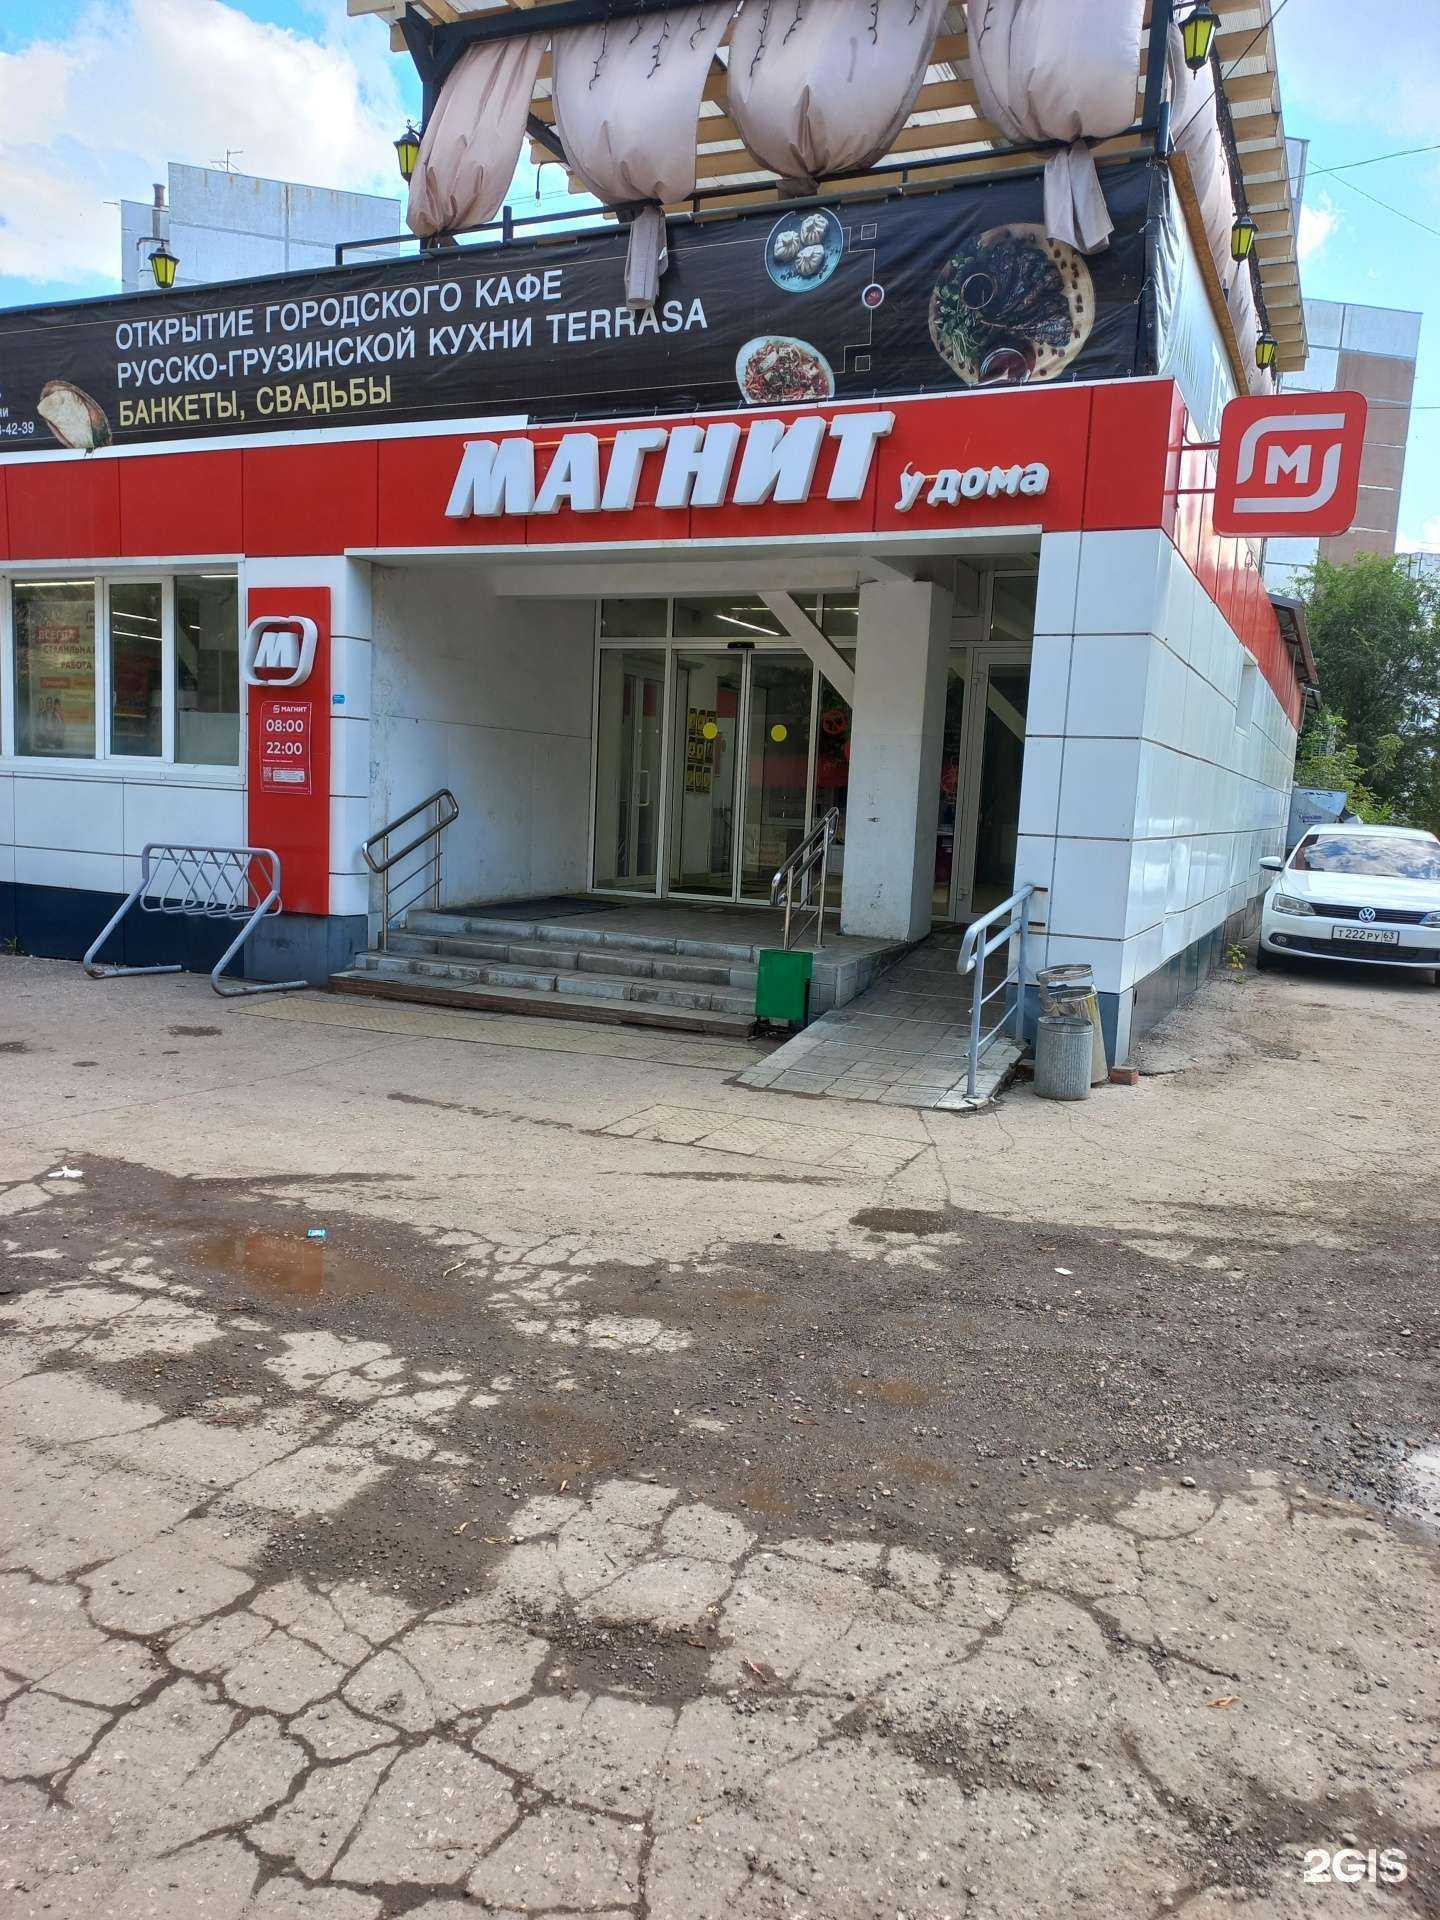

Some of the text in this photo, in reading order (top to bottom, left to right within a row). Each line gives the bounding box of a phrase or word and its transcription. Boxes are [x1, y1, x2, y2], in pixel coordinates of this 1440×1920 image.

[115, 269, 563, 350] ОТКРЫТИЕ ГОРОДСКОГО КАФЕ
[117, 298, 708, 388] РУССКО-ГРУЗИНСКОЙ КУХНИ TERRASA
[119, 375, 391, 426] БАНКЕТЫ, СВАДЬБЫ
[444, 410, 896, 519] МАГНИТ
[927, 462, 1050, 507] дома
[266, 719, 304, 733] 08:00
[281, 705, 308, 713] МАГНИТ
[266, 741, 303, 755] 22:00
